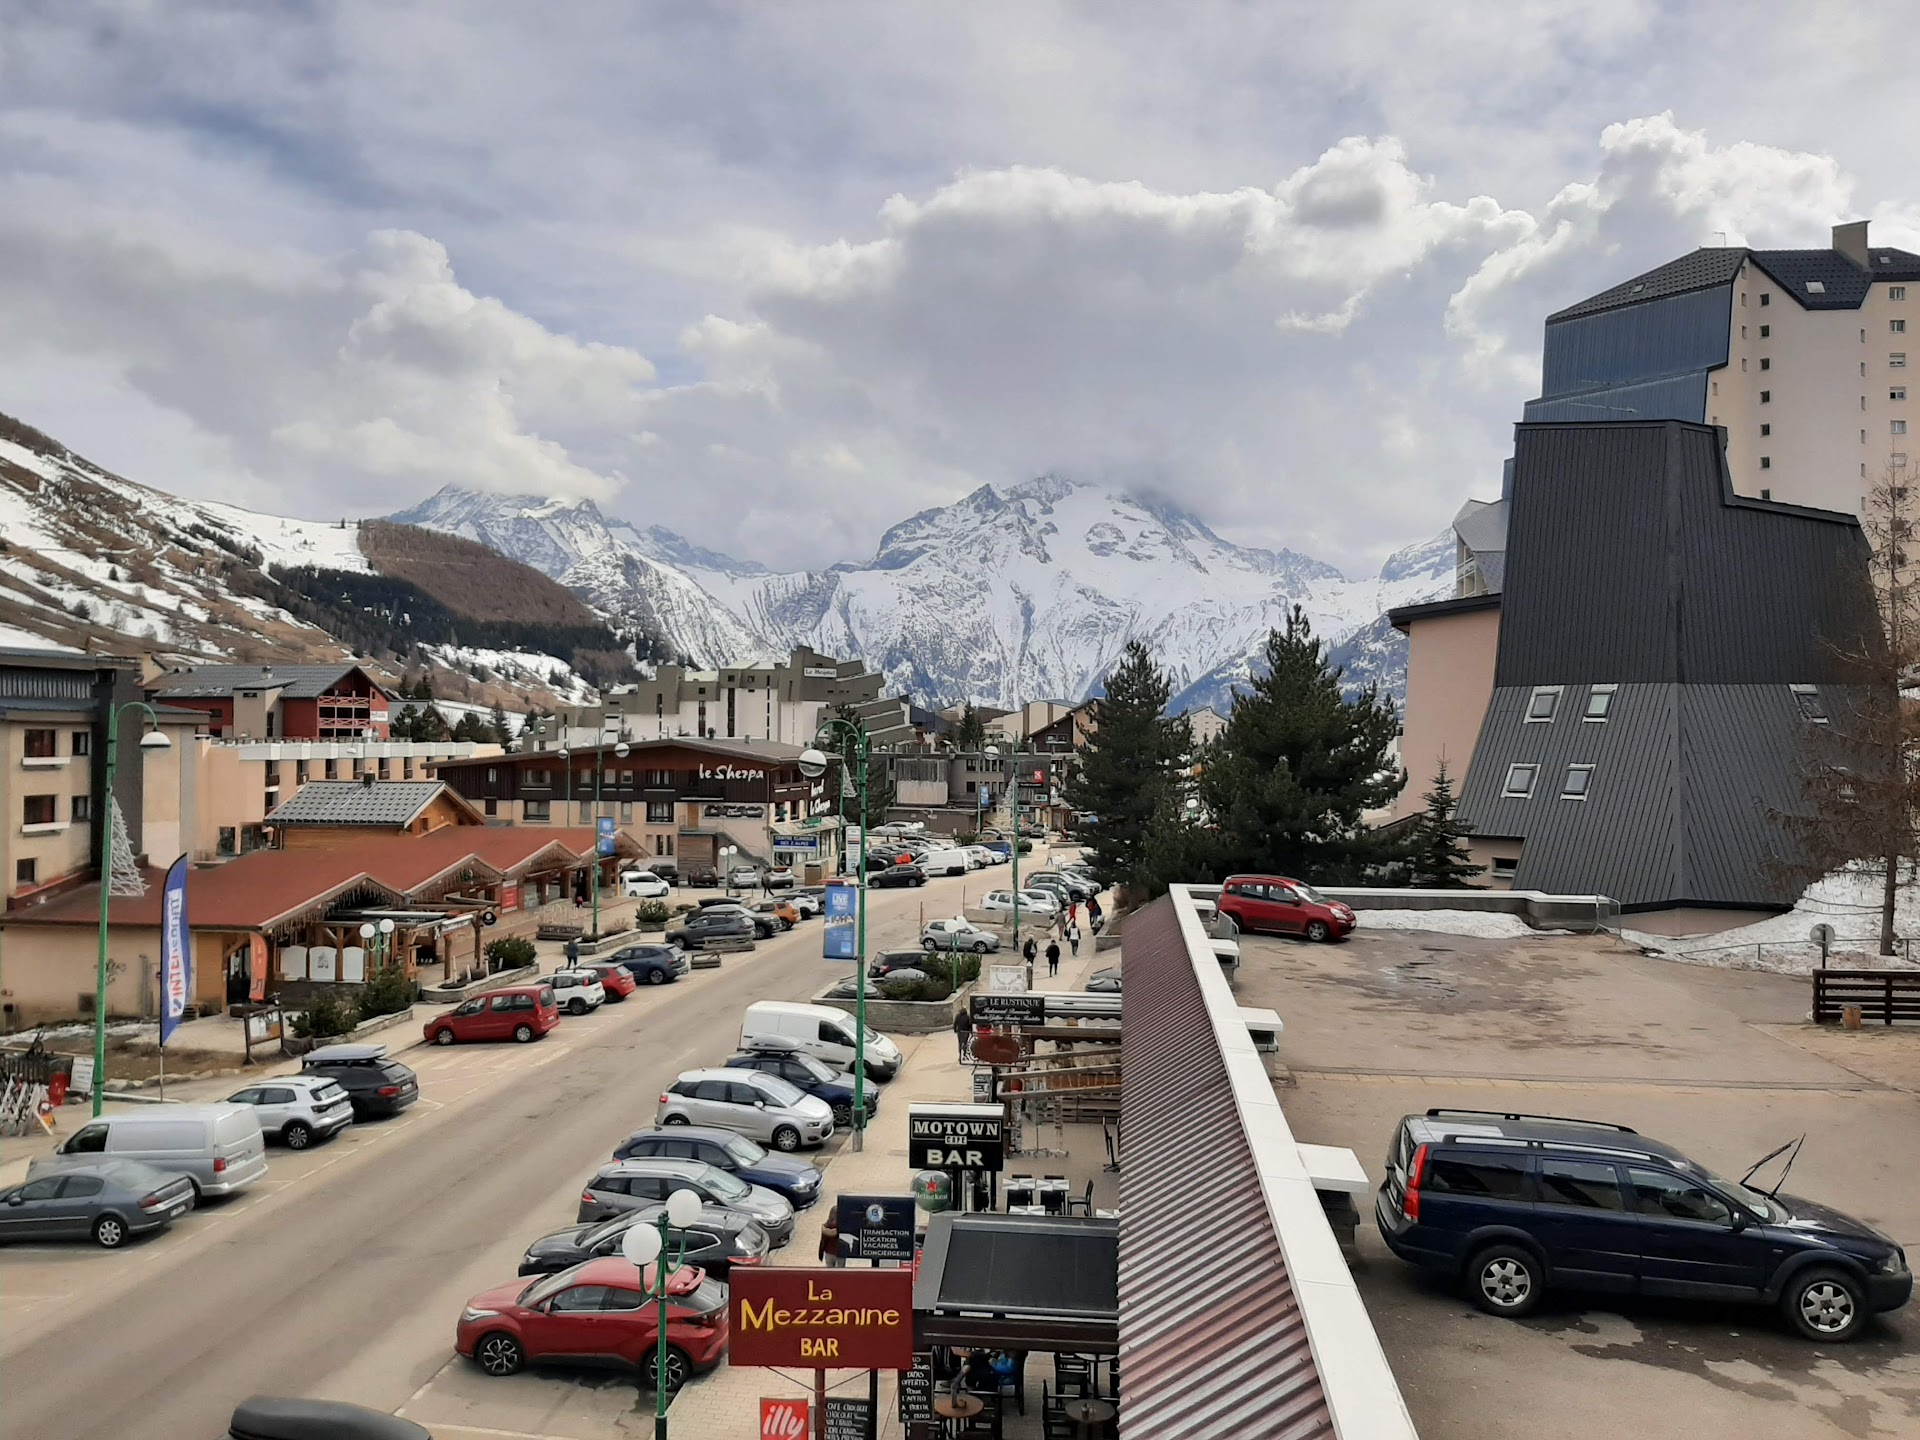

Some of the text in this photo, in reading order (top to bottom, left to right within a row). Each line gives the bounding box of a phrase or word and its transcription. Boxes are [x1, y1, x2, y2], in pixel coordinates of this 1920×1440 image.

[714, 763, 764, 782] Sherpa
[989, 998, 1040, 1007] LE RUSTIQUE
[913, 1120, 999, 1136] MOTOWN
[926, 1148, 985, 1166] BAR
[807, 1279, 833, 1301] La
[740, 1296, 900, 1332] Mezzanine
[800, 1337, 839, 1357] BAR
[762, 1404, 805, 1440] illy
